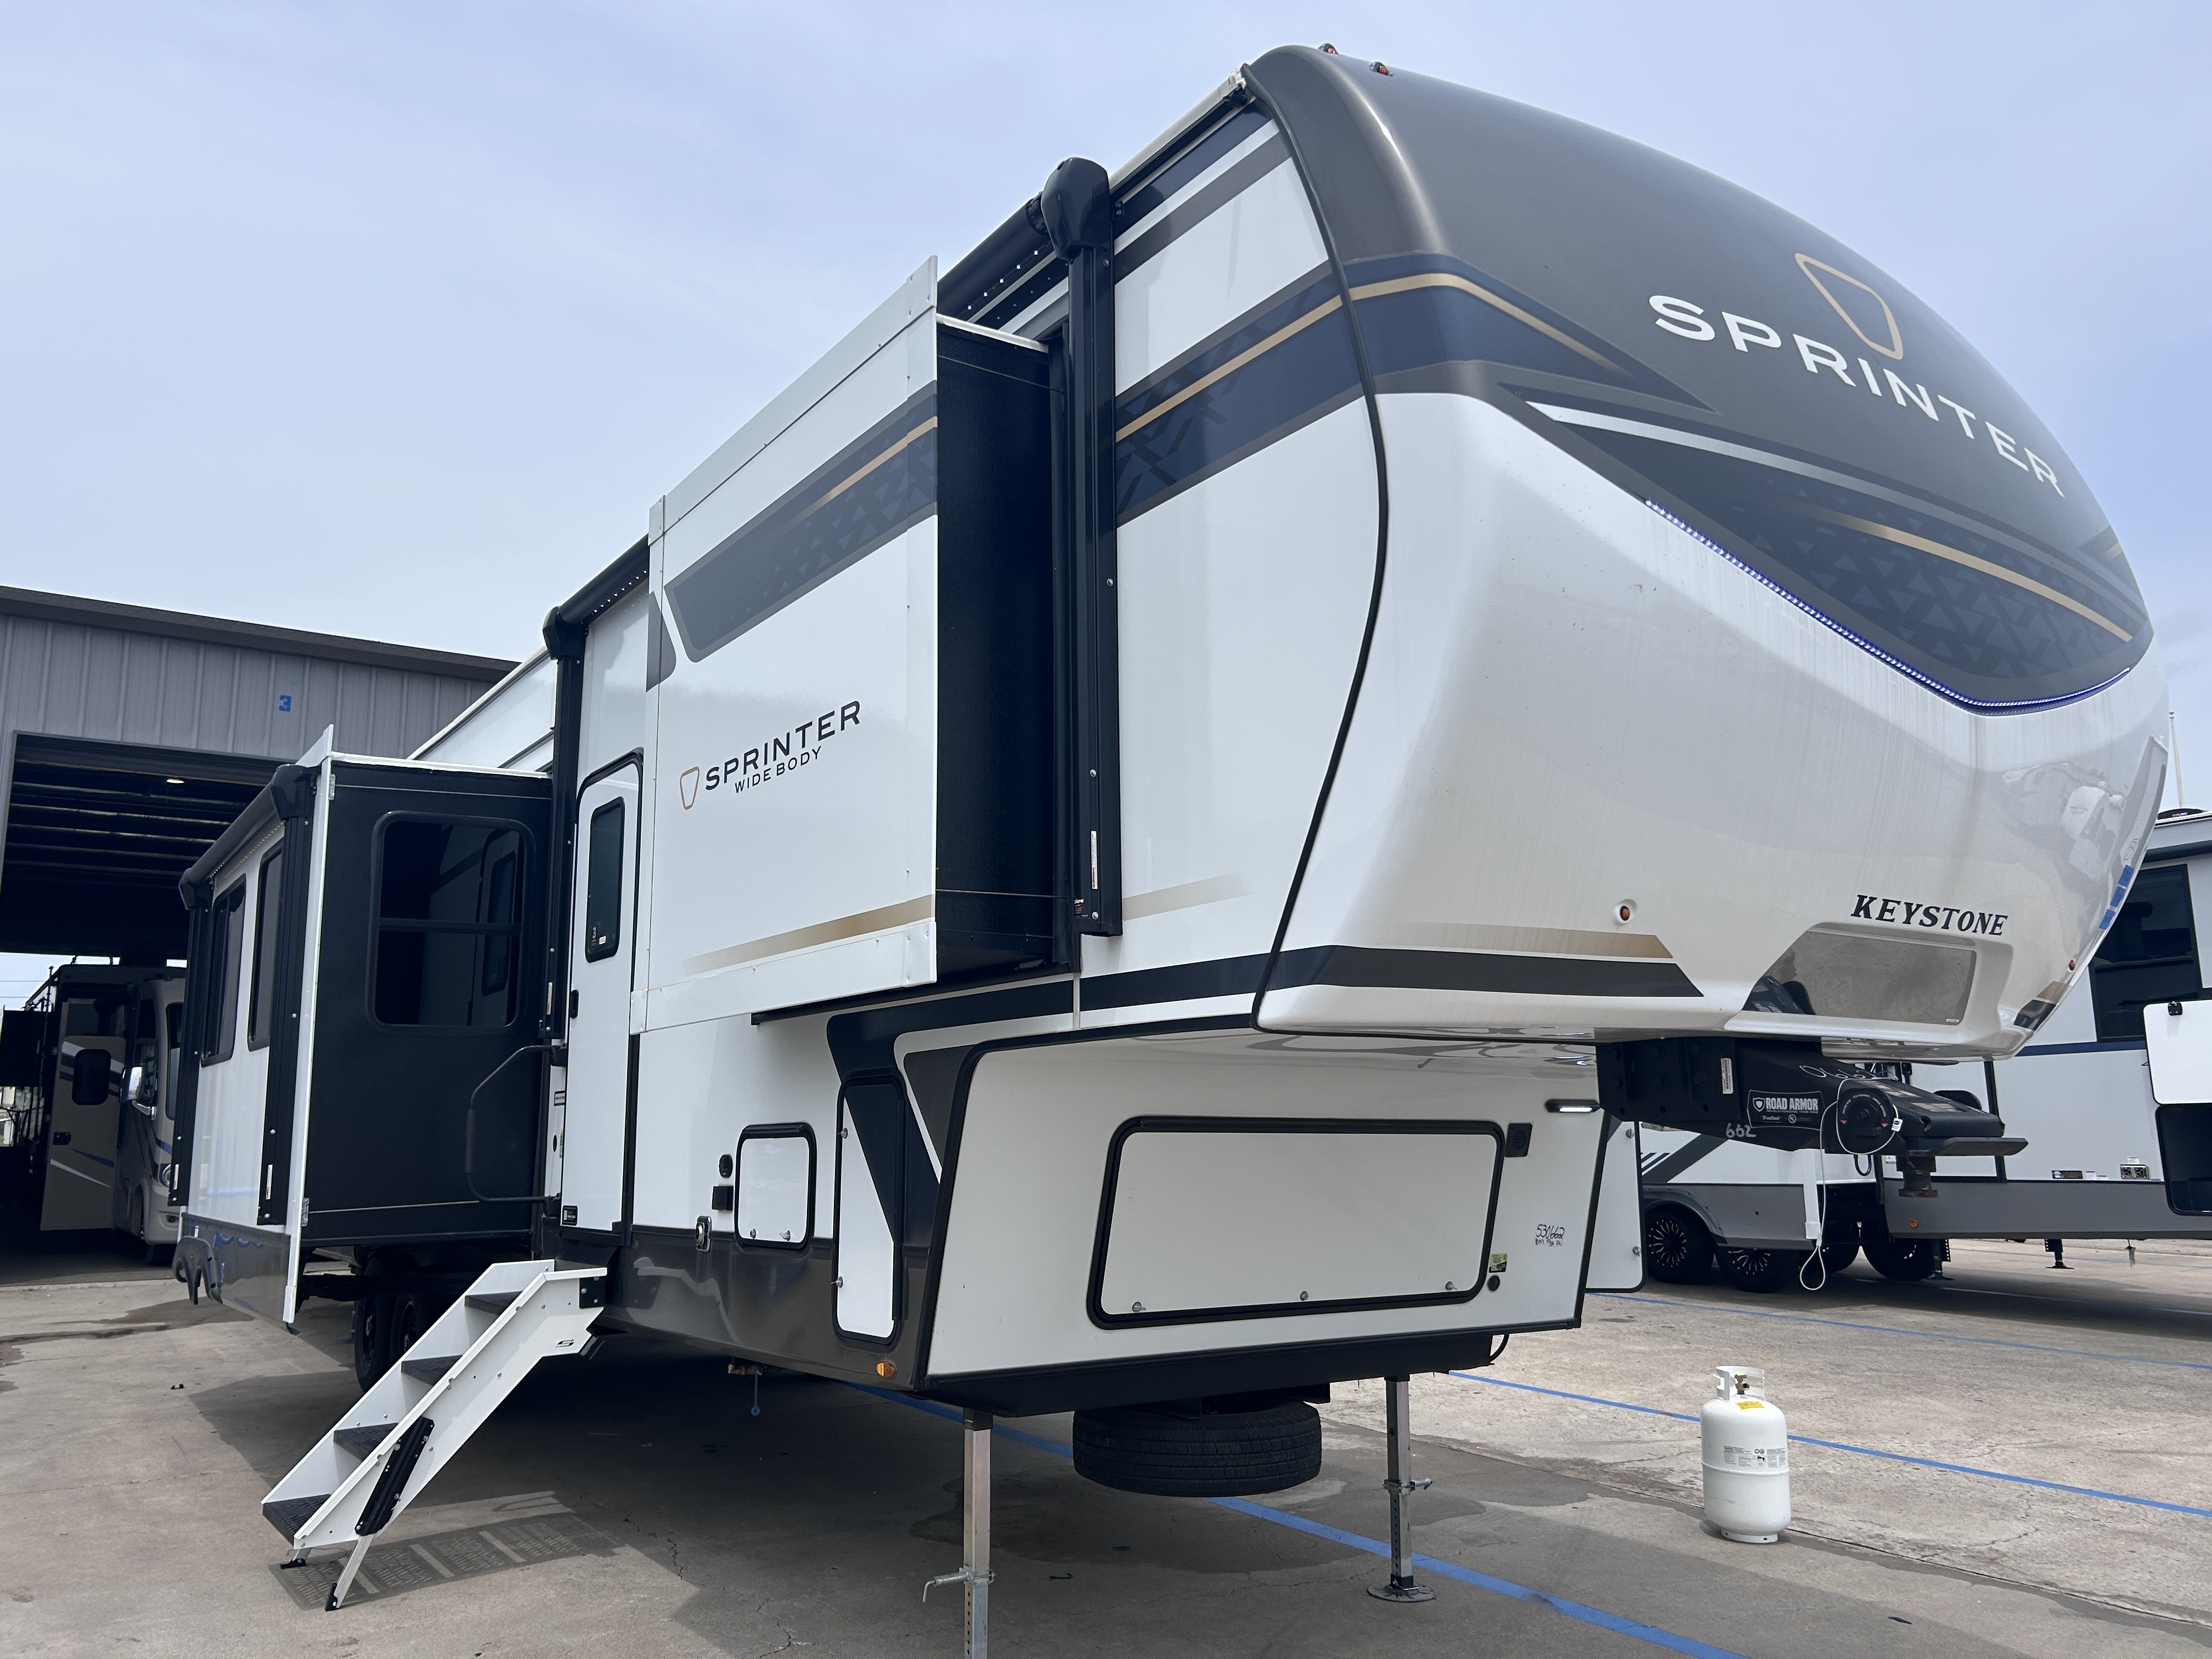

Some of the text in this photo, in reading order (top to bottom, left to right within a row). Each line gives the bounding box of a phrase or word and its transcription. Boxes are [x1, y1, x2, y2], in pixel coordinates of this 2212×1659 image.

[1649, 295, 2065, 497] SPRINTER
[279, 695, 291, 712] 3
[705, 701, 860, 791] SPRINTER
[735, 746, 821, 793] WIDE BODY
[1850, 894, 2008, 936] KEYSTONE
[1765, 1097, 1819, 1110] ROAD ARMOR
[1726, 1122, 1756, 1138] 662
[1536, 1224, 1565, 1239] 530662
